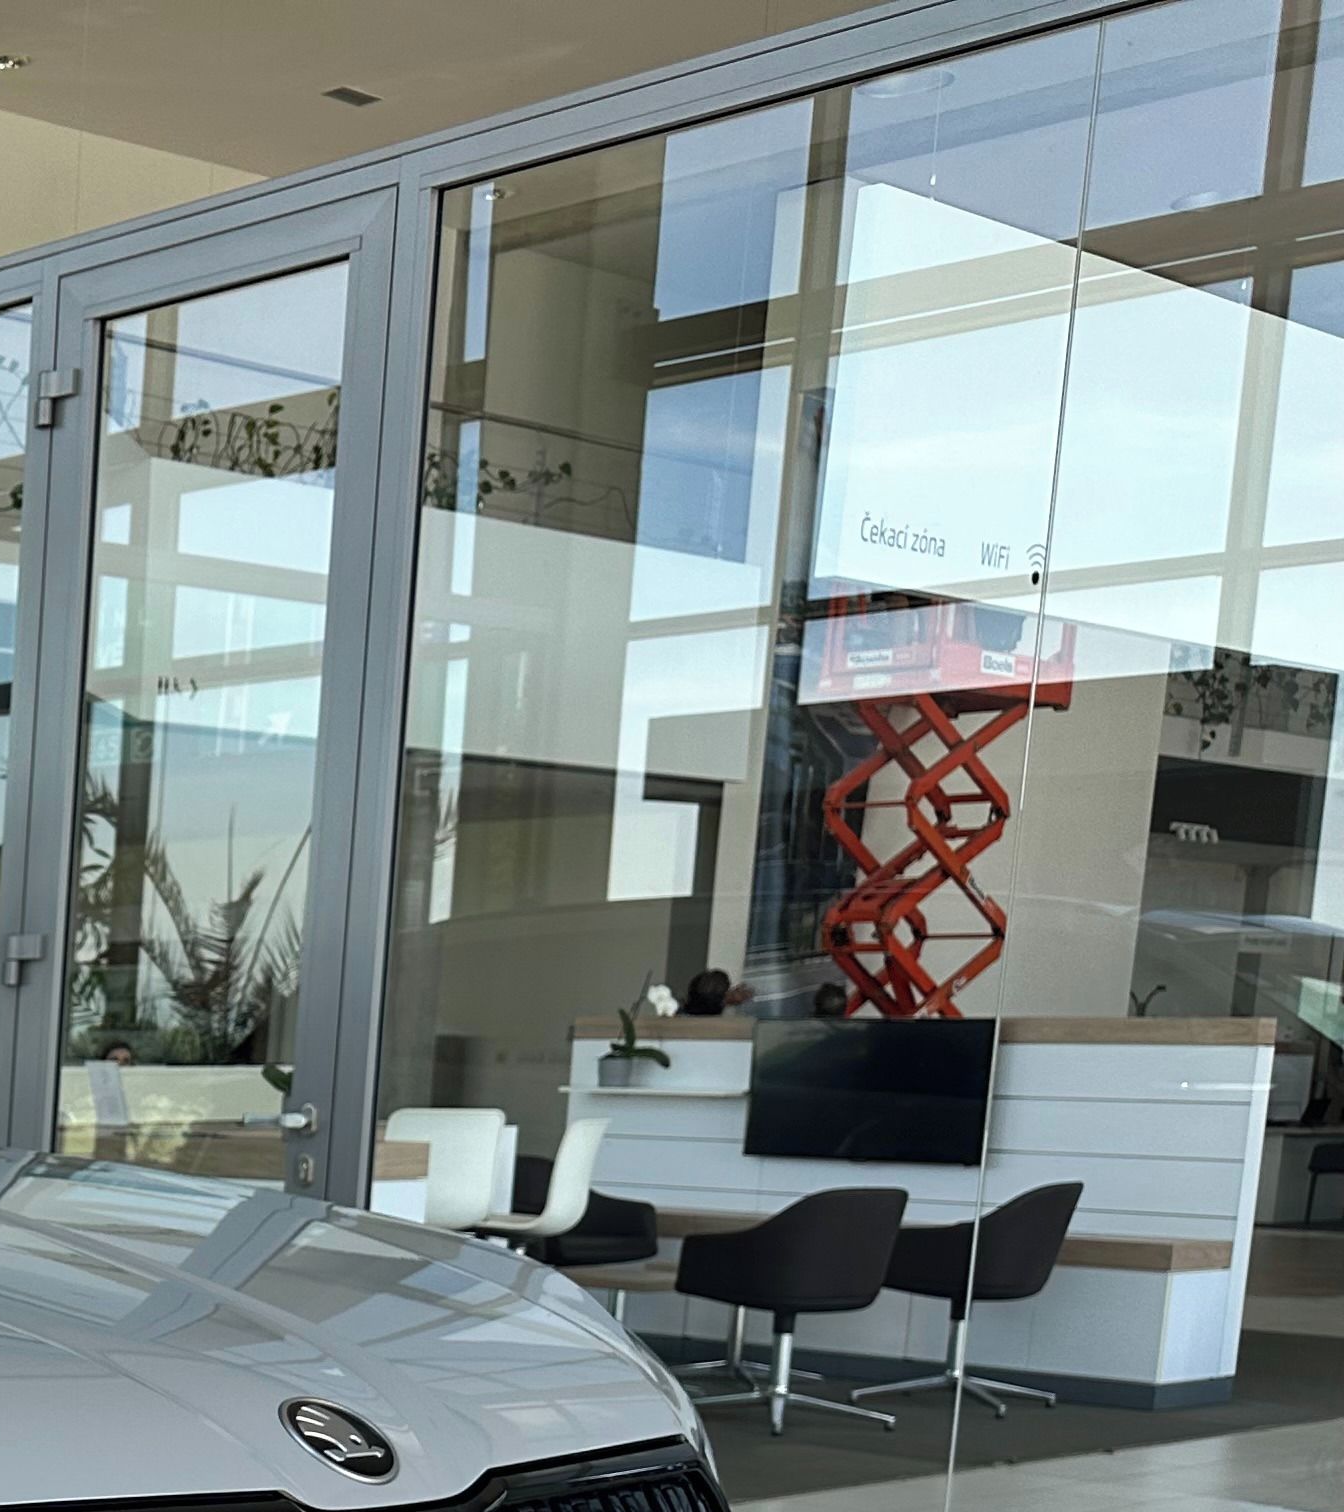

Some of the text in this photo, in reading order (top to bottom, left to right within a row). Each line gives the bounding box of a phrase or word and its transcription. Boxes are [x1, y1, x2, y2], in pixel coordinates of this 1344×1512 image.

[860, 511, 947, 558] Čekací zóna
[980, 541, 1010, 570] WiFi
